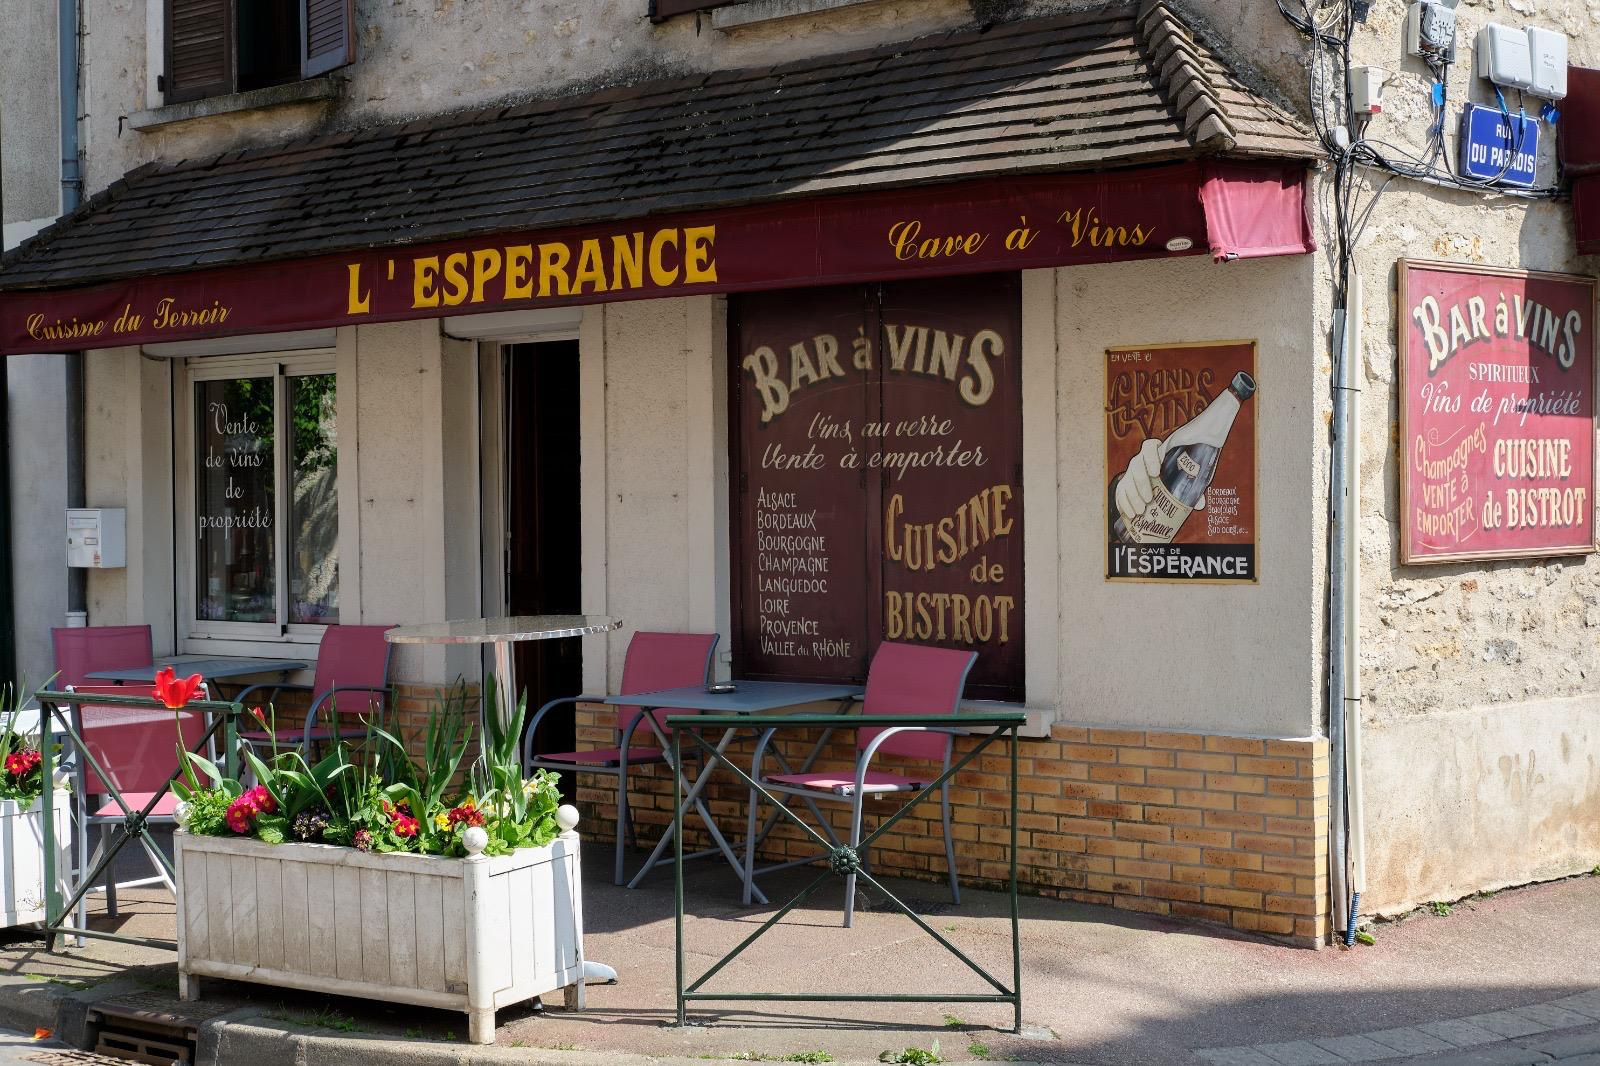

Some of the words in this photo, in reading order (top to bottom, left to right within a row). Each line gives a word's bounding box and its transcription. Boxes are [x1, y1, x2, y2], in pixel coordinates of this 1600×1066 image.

[1471, 142, 1487, 164] DU
[888, 220, 989, 261] Cave
[1005, 216, 1040, 251] à
[1057, 206, 1156, 248] Vins
[26, 313, 107, 340] Cuisine
[114, 304, 146, 334] du
[153, 297, 233, 330] Terroir
[1412, 296, 1490, 371] BAR
[1495, 292, 1508, 334] à
[1513, 294, 1582, 368] VINS
[743, 338, 846, 422] BAR
[853, 326, 873, 370] à
[885, 324, 1004, 406] VINS
[1469, 362, 1540, 384] SPIRITUEUX
[210, 402, 259, 435] Vente
[1421, 380, 1462, 416] Vins
[1470, 389, 1493, 413] de
[1493, 390, 1583, 427] propriété
[807, 412, 852, 444] Vins
[861, 422, 890, 437] au
[895, 414, 955, 436] verre
[206, 446, 225, 468] de
[230, 447, 264, 467] vins
[762, 443, 825, 469] Vente
[839, 447, 860, 468] à
[867, 440, 988, 481] emporter
[1415, 421, 1487, 479] Champagnes
[1493, 438, 1572, 479] CUISINE
[225, 477, 244, 499] de
[757, 487, 797, 510] ALSACE
[1422, 477, 1457, 510] VENTE
[1461, 470, 1469, 494] à
[200, 506, 272, 539] propriété
[757, 509, 817, 532] BORDEAUX
[1416, 497, 1475, 543] EMPORTER
[1482, 491, 1502, 529] de
[1506, 487, 1586, 528] BISTROT
[757, 531, 826, 555] BOURGOGNE
[886, 484, 1014, 571] CUISINE
[758, 553, 829, 577] CHAMPAGNE
[970, 555, 1005, 583] de
[758, 575, 827, 594] LANGUEDOC
[759, 594, 790, 614] LOIRE
[886, 590, 1015, 645] BISTROT
[760, 615, 819, 637] PROVENCE
[760, 635, 796, 657] VALLEE
[797, 645, 809, 656] du
[812, 638, 851, 660] RHÔNE
